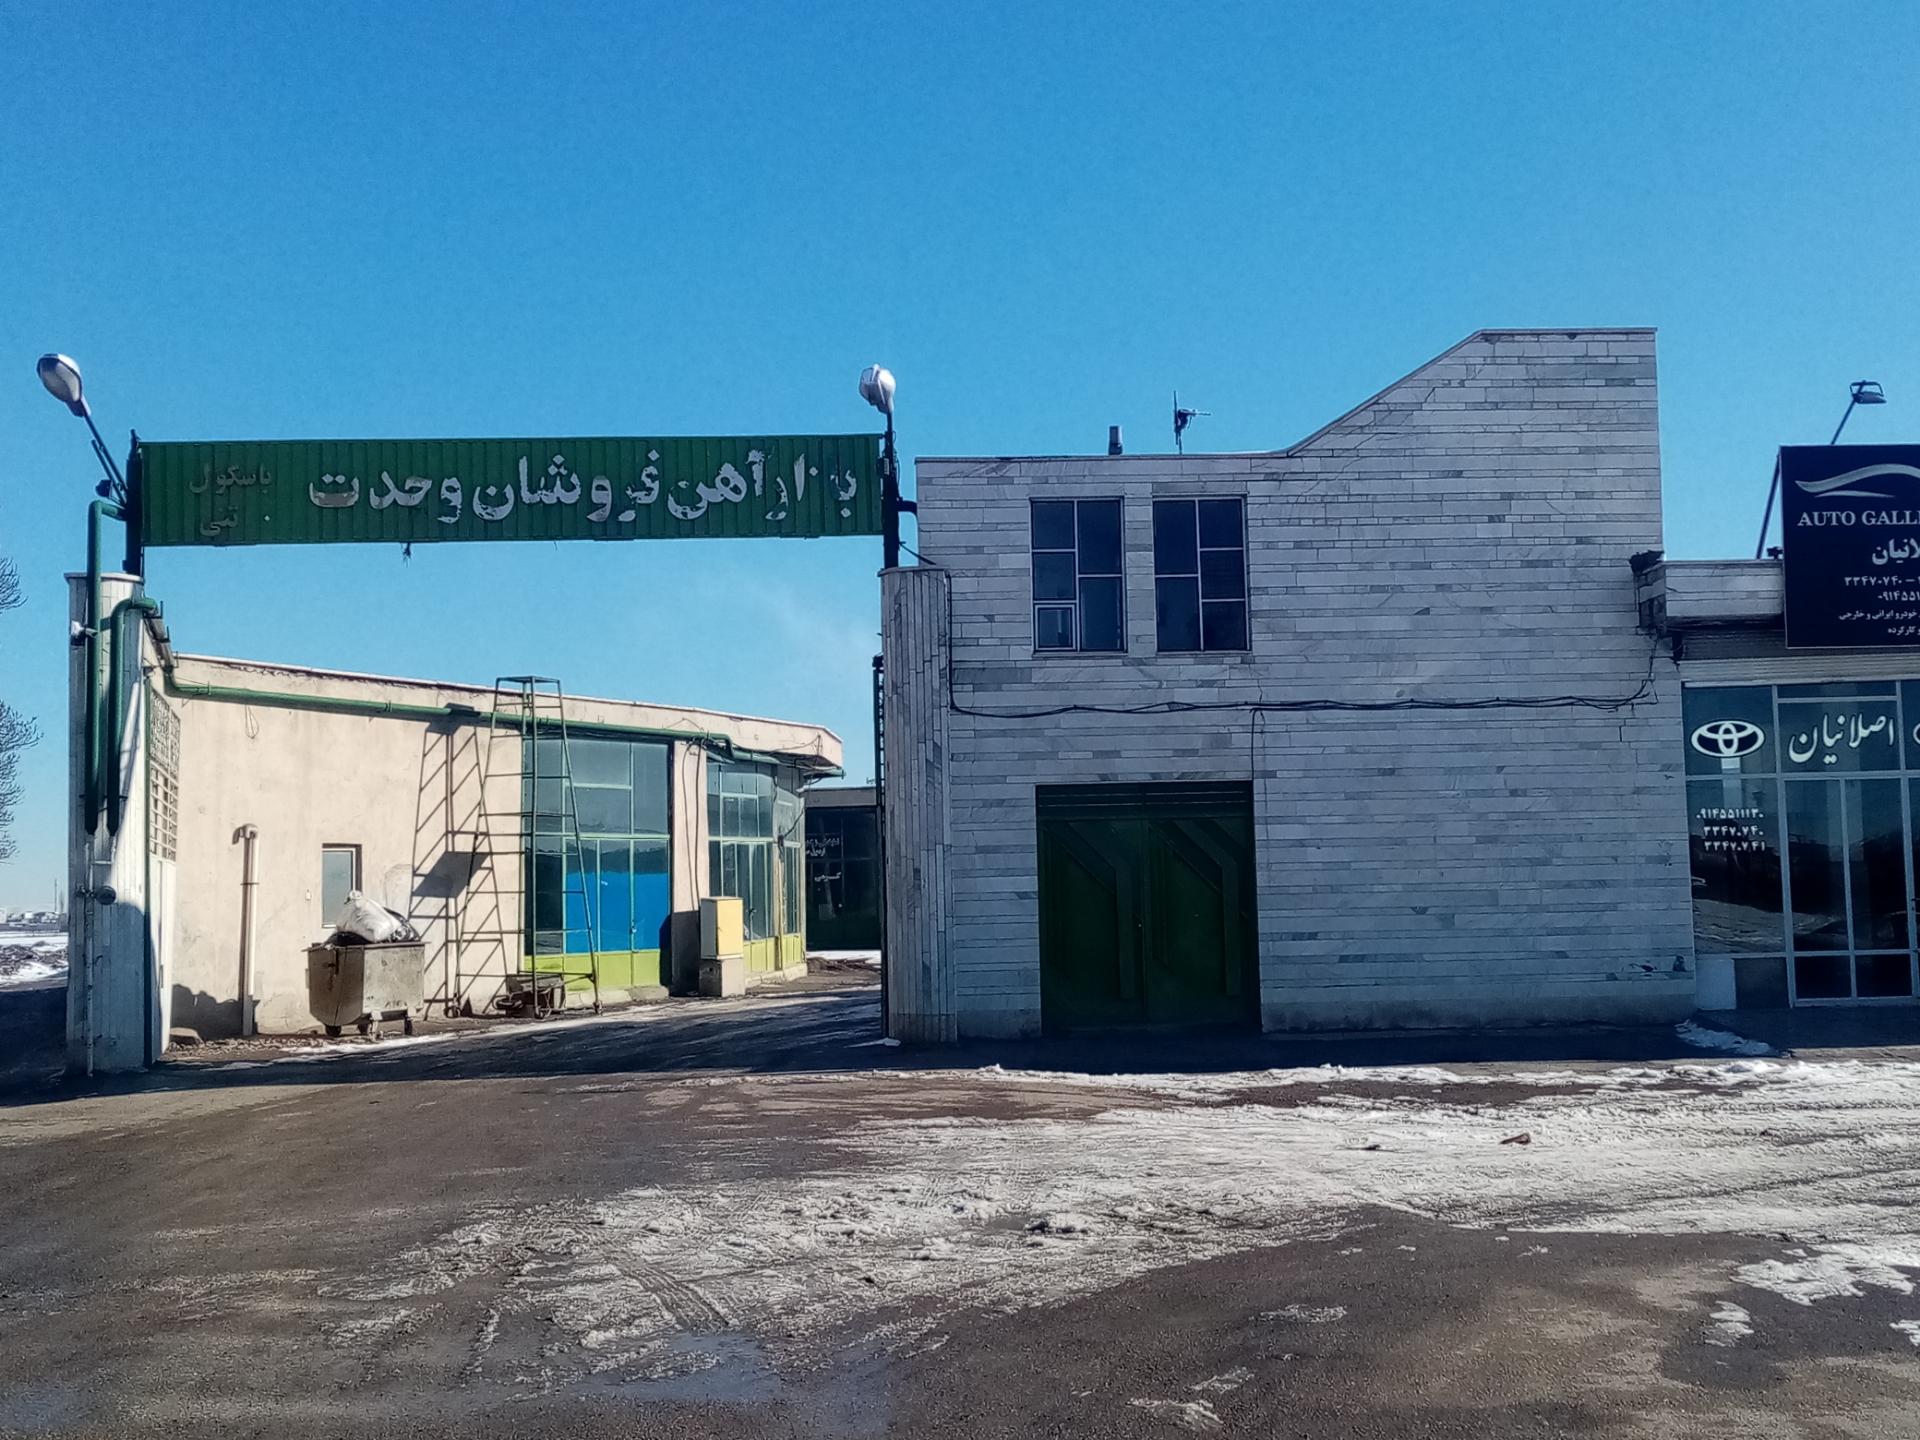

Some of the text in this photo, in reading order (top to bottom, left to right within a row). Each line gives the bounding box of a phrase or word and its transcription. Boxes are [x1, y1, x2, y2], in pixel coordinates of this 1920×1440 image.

[189, 463, 273, 495] باسکول
[309, 470, 463, 523] وحدت
[1797, 511, 1856, 526] AUTO
[1788, 711, 1896, 764] اصلانیان
[1696, 807, 1764, 819] ۰۹۱۴۵۵۱۱۱۳۰
